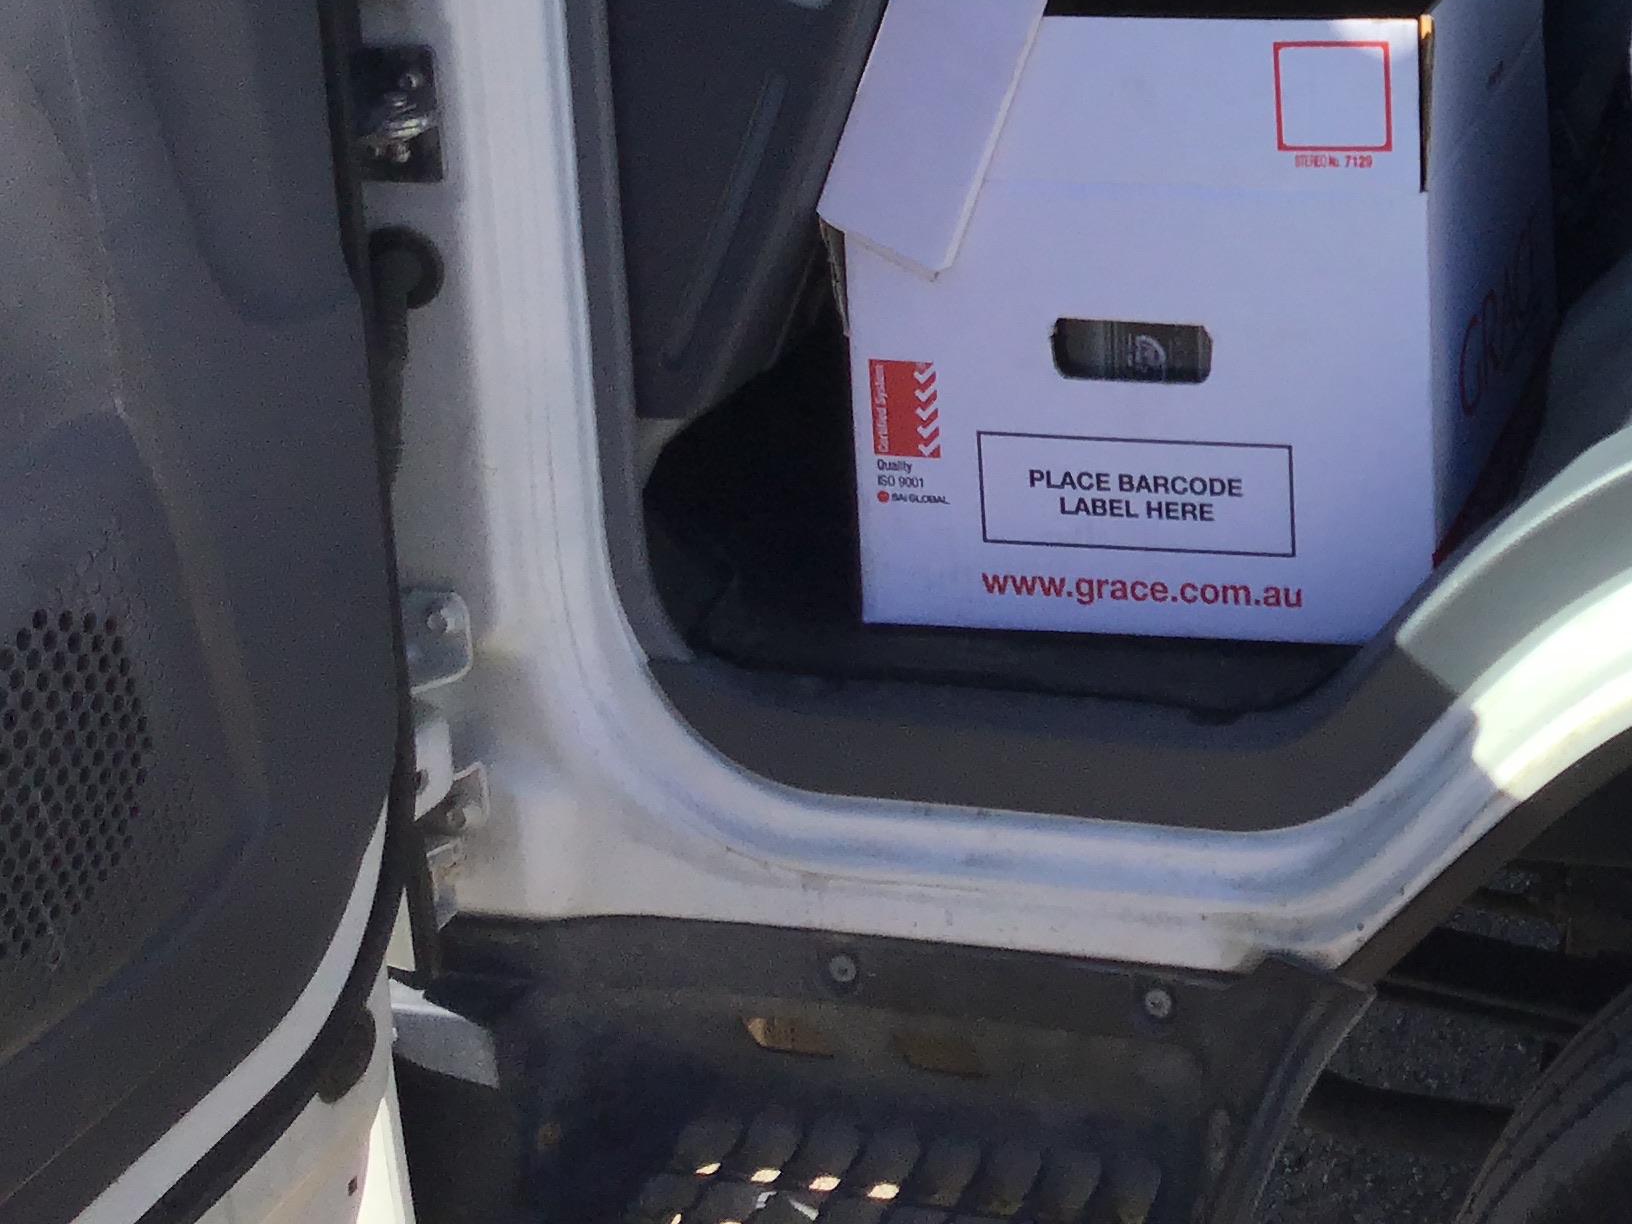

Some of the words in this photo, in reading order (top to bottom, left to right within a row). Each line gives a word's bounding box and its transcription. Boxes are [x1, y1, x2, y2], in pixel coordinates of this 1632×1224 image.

[877, 459, 912, 474] Quality
[877, 474, 896, 487] ISO
[898, 476, 924, 489] 9001
[1028, 468, 1111, 492] PLACE
[1117, 473, 1244, 498] BARCODE
[1059, 497, 1140, 519] LABEL
[1146, 500, 1216, 522] HERE
[981, 571, 1303, 608] www.grace.com.au
